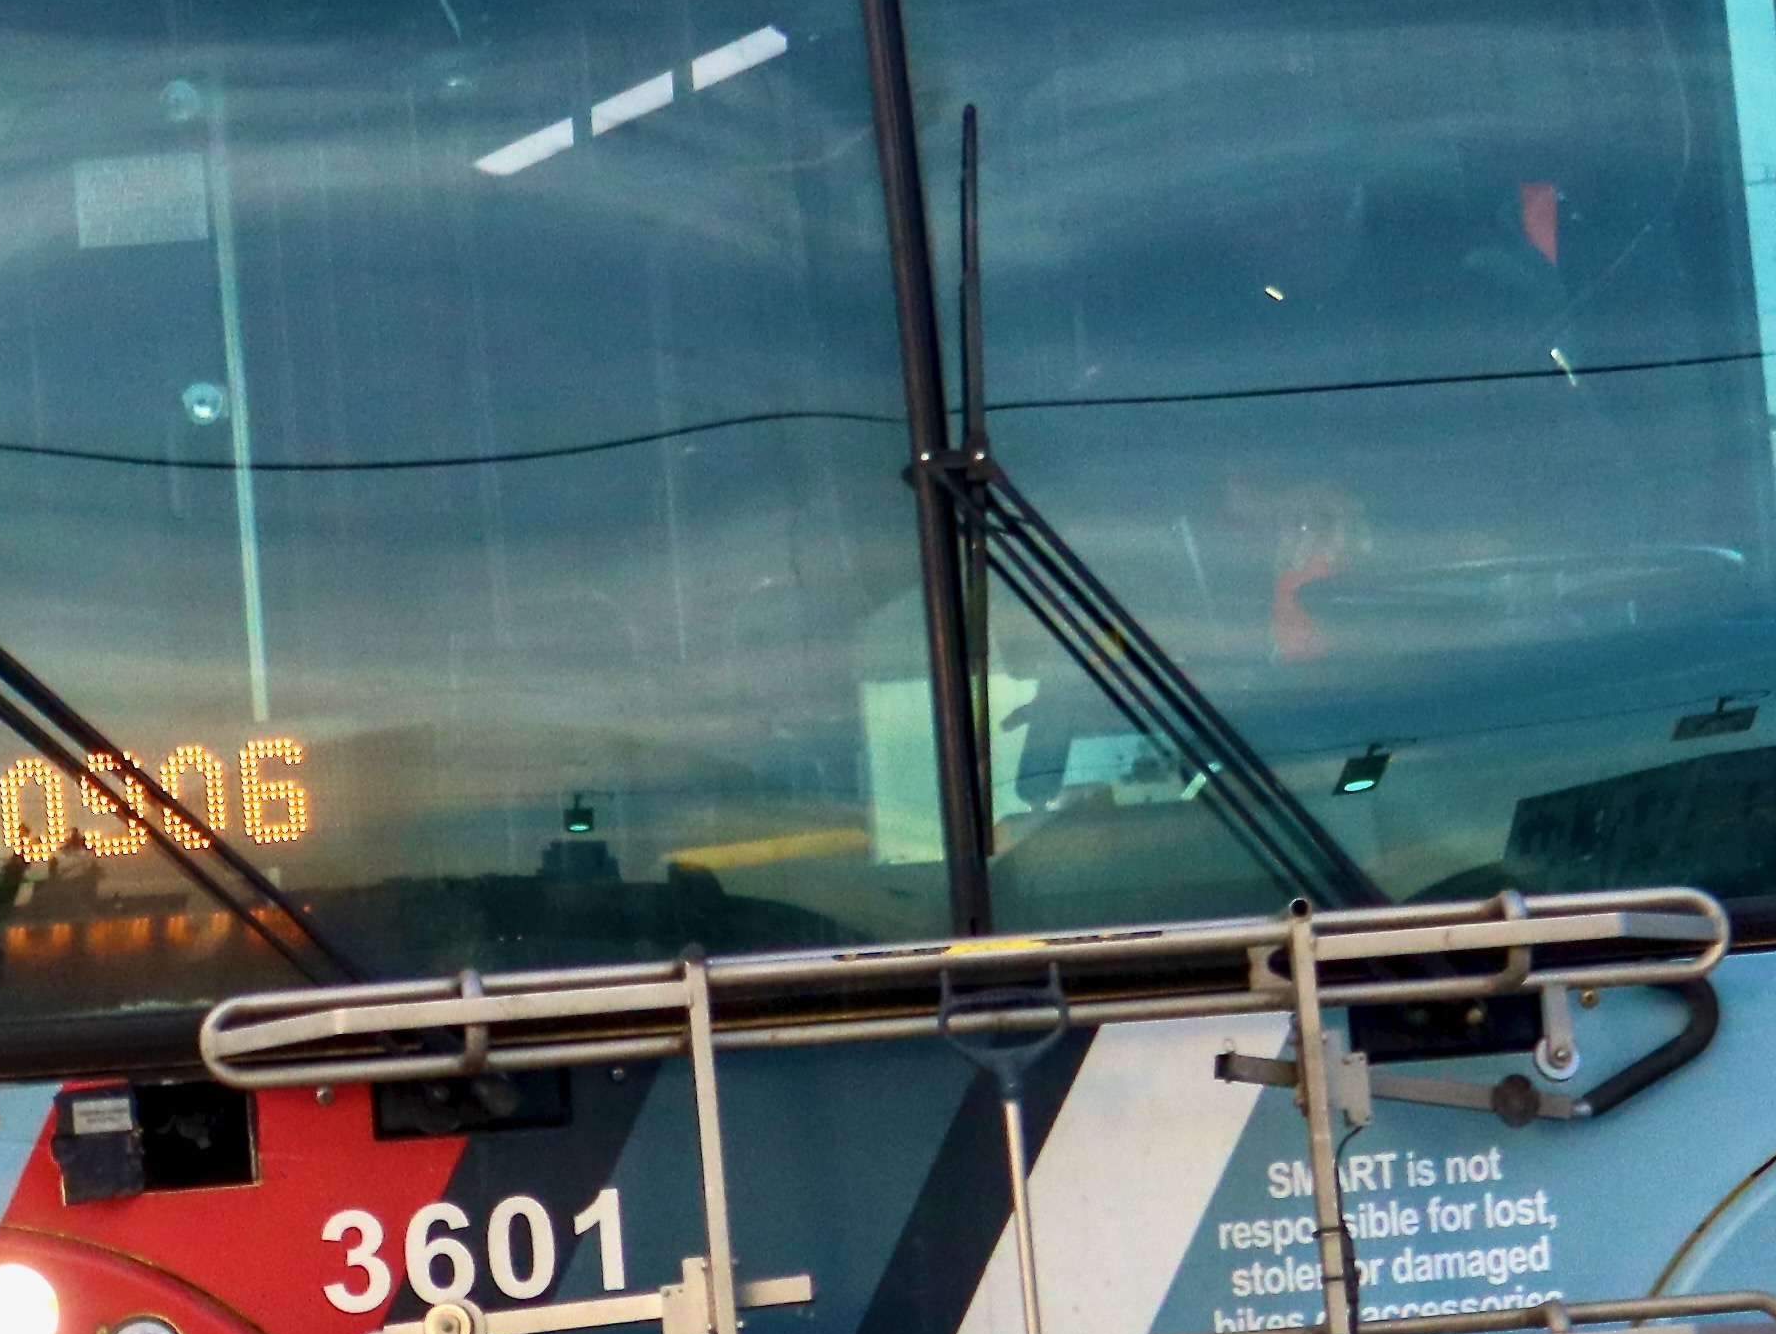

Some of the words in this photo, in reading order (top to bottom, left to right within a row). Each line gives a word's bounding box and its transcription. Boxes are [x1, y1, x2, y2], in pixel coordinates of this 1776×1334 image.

[1406, 1151, 1437, 1188] is
[1445, 1146, 1504, 1185] not
[321, 1187, 627, 1314] 3601
[1218, 1199, 1420, 1256] resposible
[1426, 1195, 1477, 1234] for
[1483, 1189, 1558, 1230] lost,
[1390, 1234, 1552, 1286] damaged
